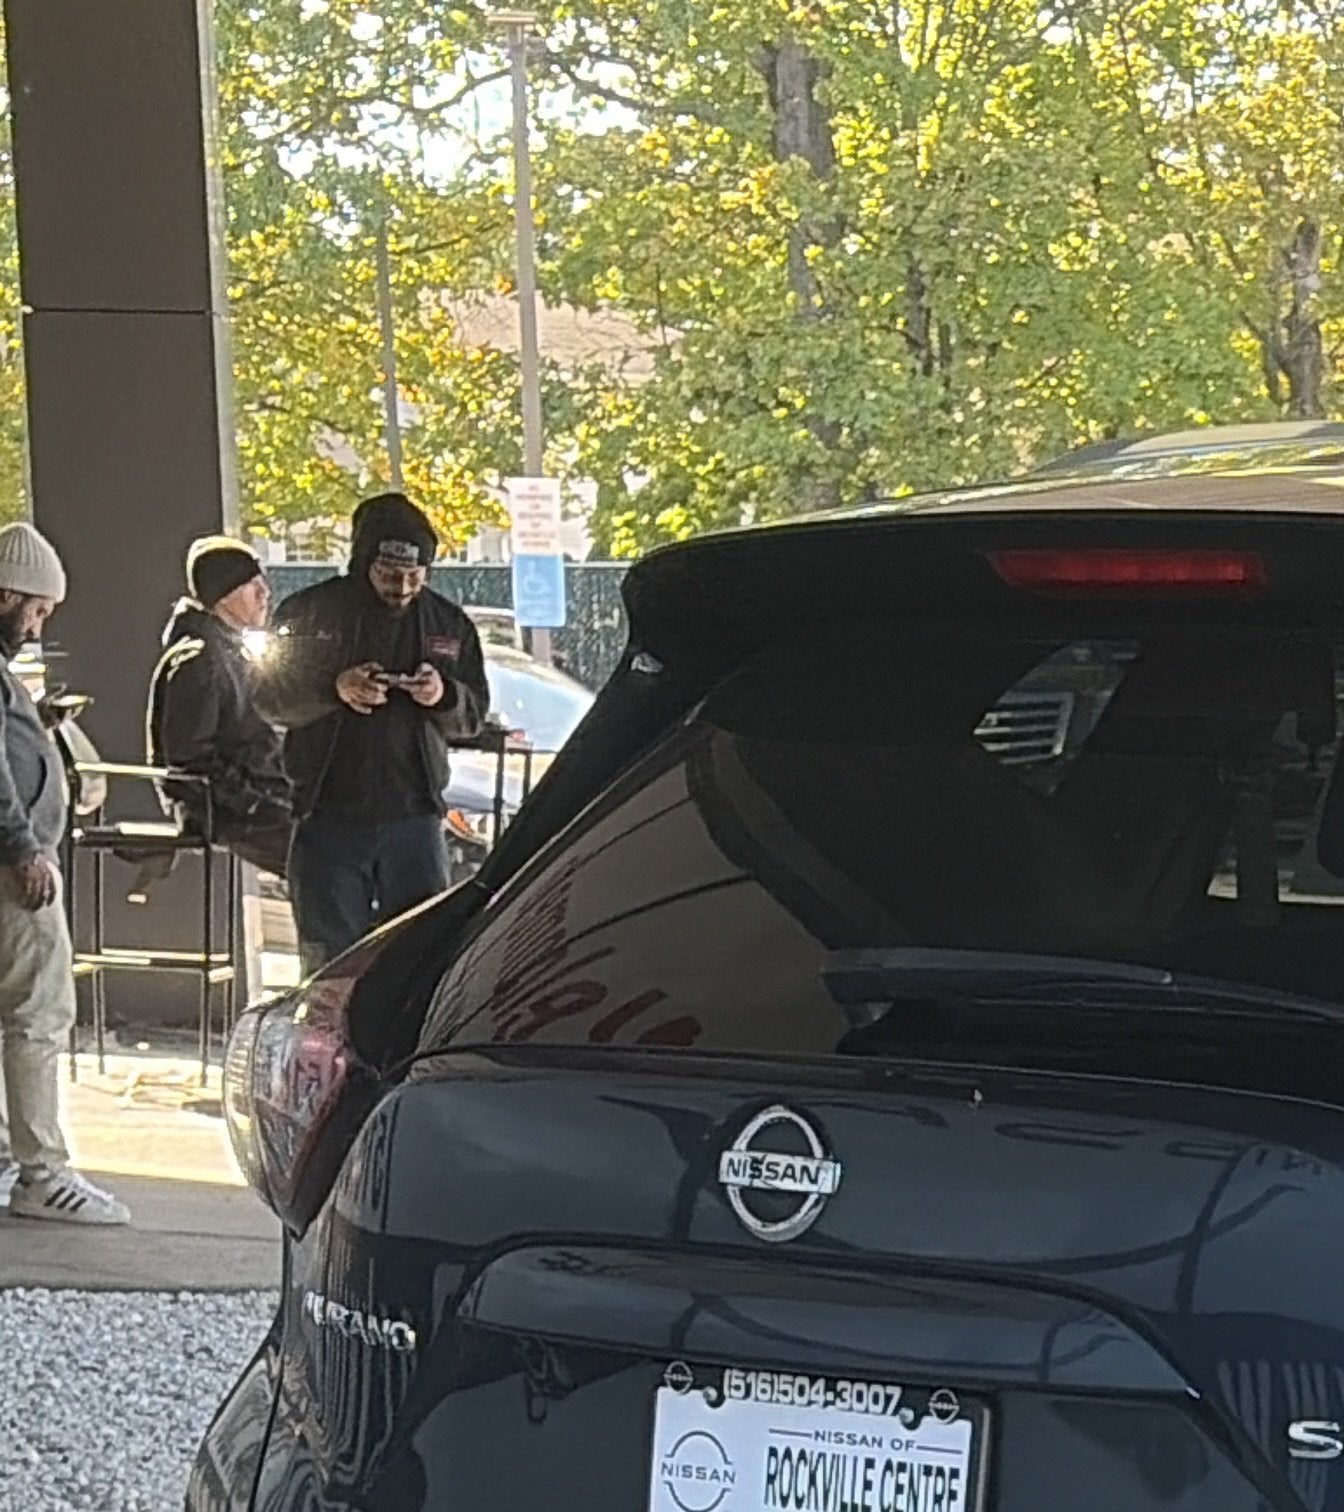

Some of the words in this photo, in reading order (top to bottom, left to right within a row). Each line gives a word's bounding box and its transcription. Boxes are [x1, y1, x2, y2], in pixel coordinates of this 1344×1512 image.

[726, 1157, 820, 1185] NISSAN
[723, 1368, 902, 1416] (516)504-3007
[813, 1430, 883, 1448] NISSAN
[890, 1438, 916, 1452] OF
[661, 1461, 737, 1484] NISSAN
